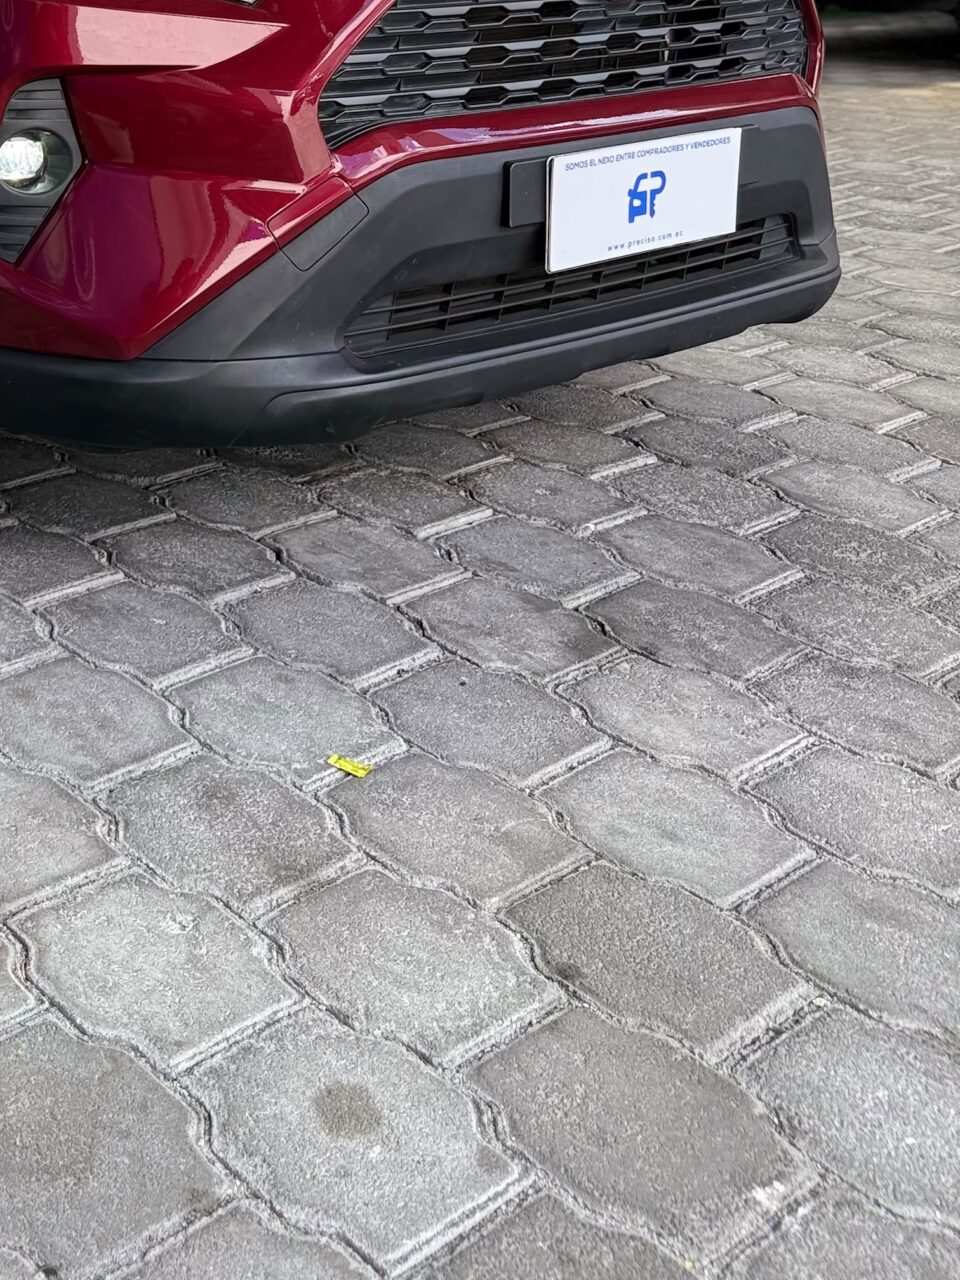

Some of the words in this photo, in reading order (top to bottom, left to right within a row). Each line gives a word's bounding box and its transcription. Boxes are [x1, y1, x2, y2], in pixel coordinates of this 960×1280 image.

[565, 160, 588, 171] SOMOS
[589, 158, 597, 167] EL
[597, 155, 615, 166] NEXO
[615, 151, 636, 162] ENTRE
[636, 143, 685, 158] COMPRADORES
[690, 136, 730, 149] VENDEDORES
